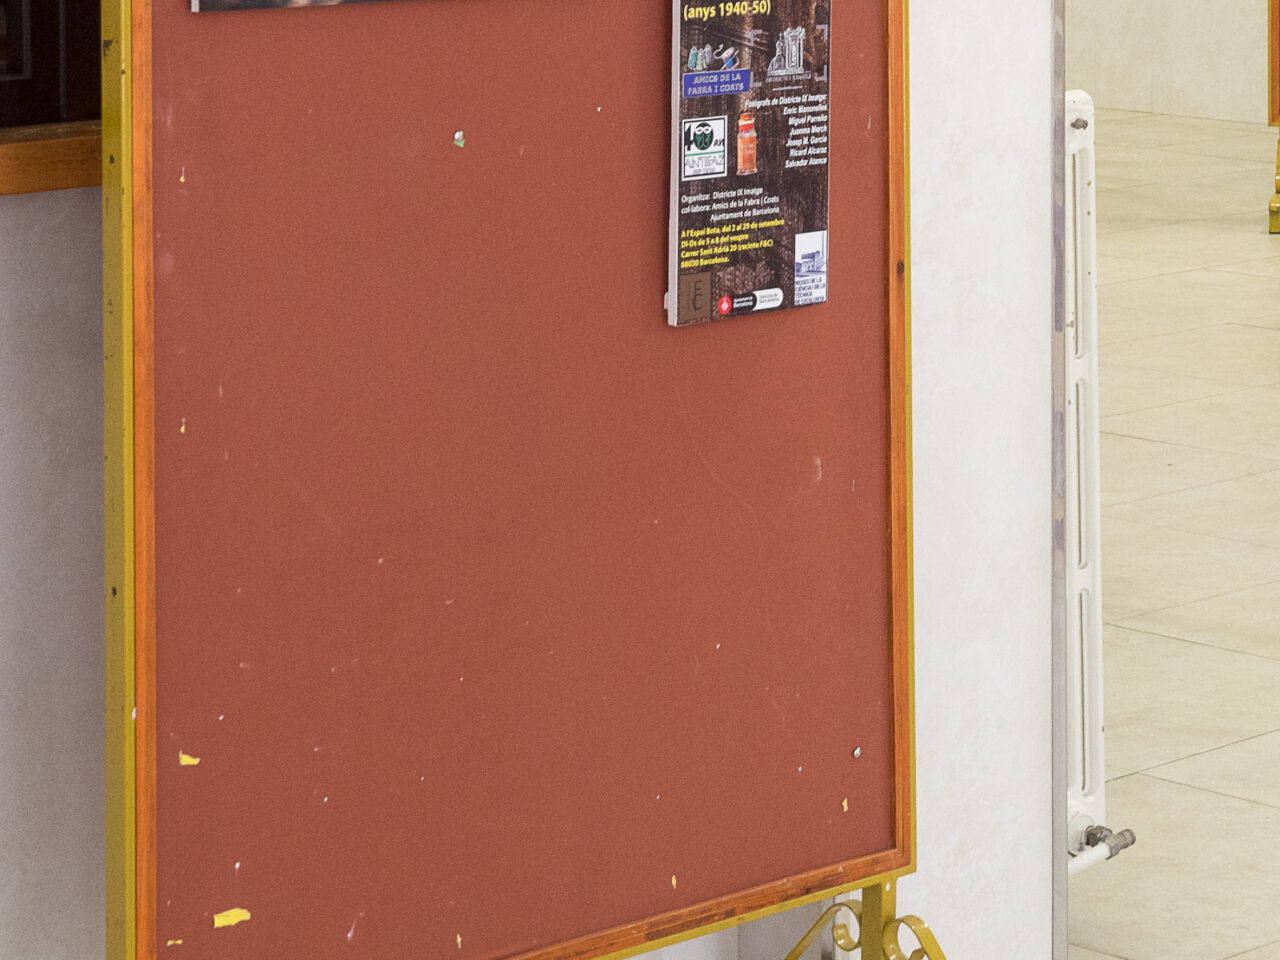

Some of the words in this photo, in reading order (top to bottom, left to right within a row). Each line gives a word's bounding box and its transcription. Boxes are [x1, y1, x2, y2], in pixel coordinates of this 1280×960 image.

[684, 2, 716, 22] (anys
[719, 0, 770, 18] 1940-50)
[694, 75, 718, 84] AMICS
[720, 74, 730, 82] DE
[688, 86, 712, 95] FABRA
[720, 83, 744, 92] COATS
[779, 95, 801, 105] Districte
[784, 106, 797, 115] Enric
[785, 158, 808, 168] Salvador
[713, 189, 736, 199] Districte
[712, 201, 728, 210] Amics
[730, 200, 737, 208] de
[744, 198, 759, 206] Fabra
[764, 195, 779, 204] Coats
[710, 210, 743, 223] Ajuntament
[744, 209, 751, 217] de
[753, 206, 779, 216] Barcelona
[722, 224, 731, 233] del
[737, 223, 742, 231] al
[751, 221, 757, 229] de
[720, 235, 729, 243] del
[681, 249, 699, 259] Carrer
[700, 247, 713, 256] Sant
